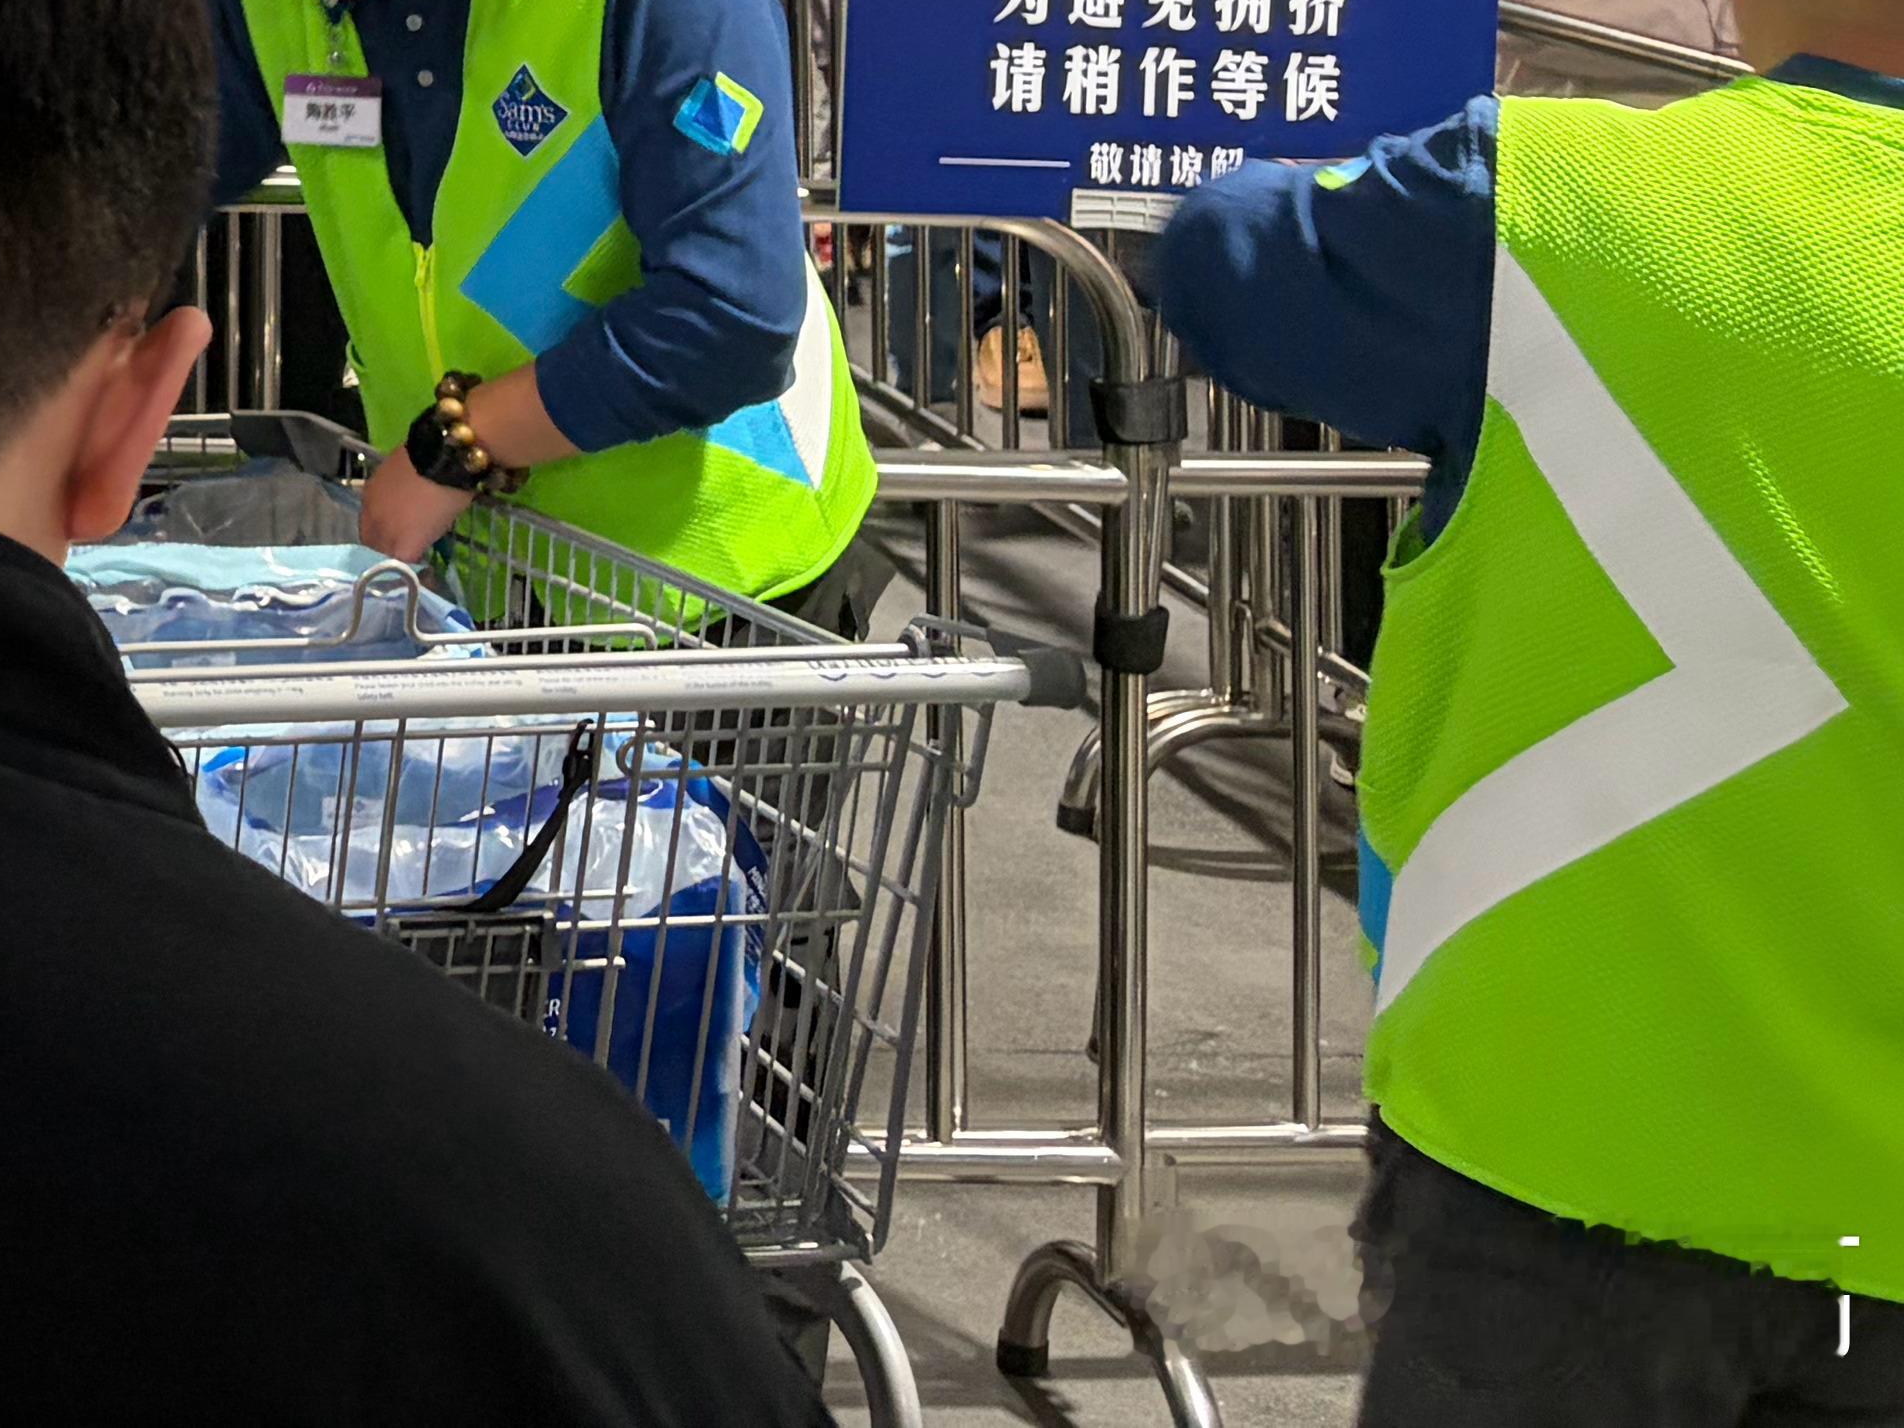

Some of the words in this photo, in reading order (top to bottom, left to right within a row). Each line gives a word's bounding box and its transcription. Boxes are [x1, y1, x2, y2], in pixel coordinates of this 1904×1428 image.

[991, 42, 1341, 121] 请稍作等候
